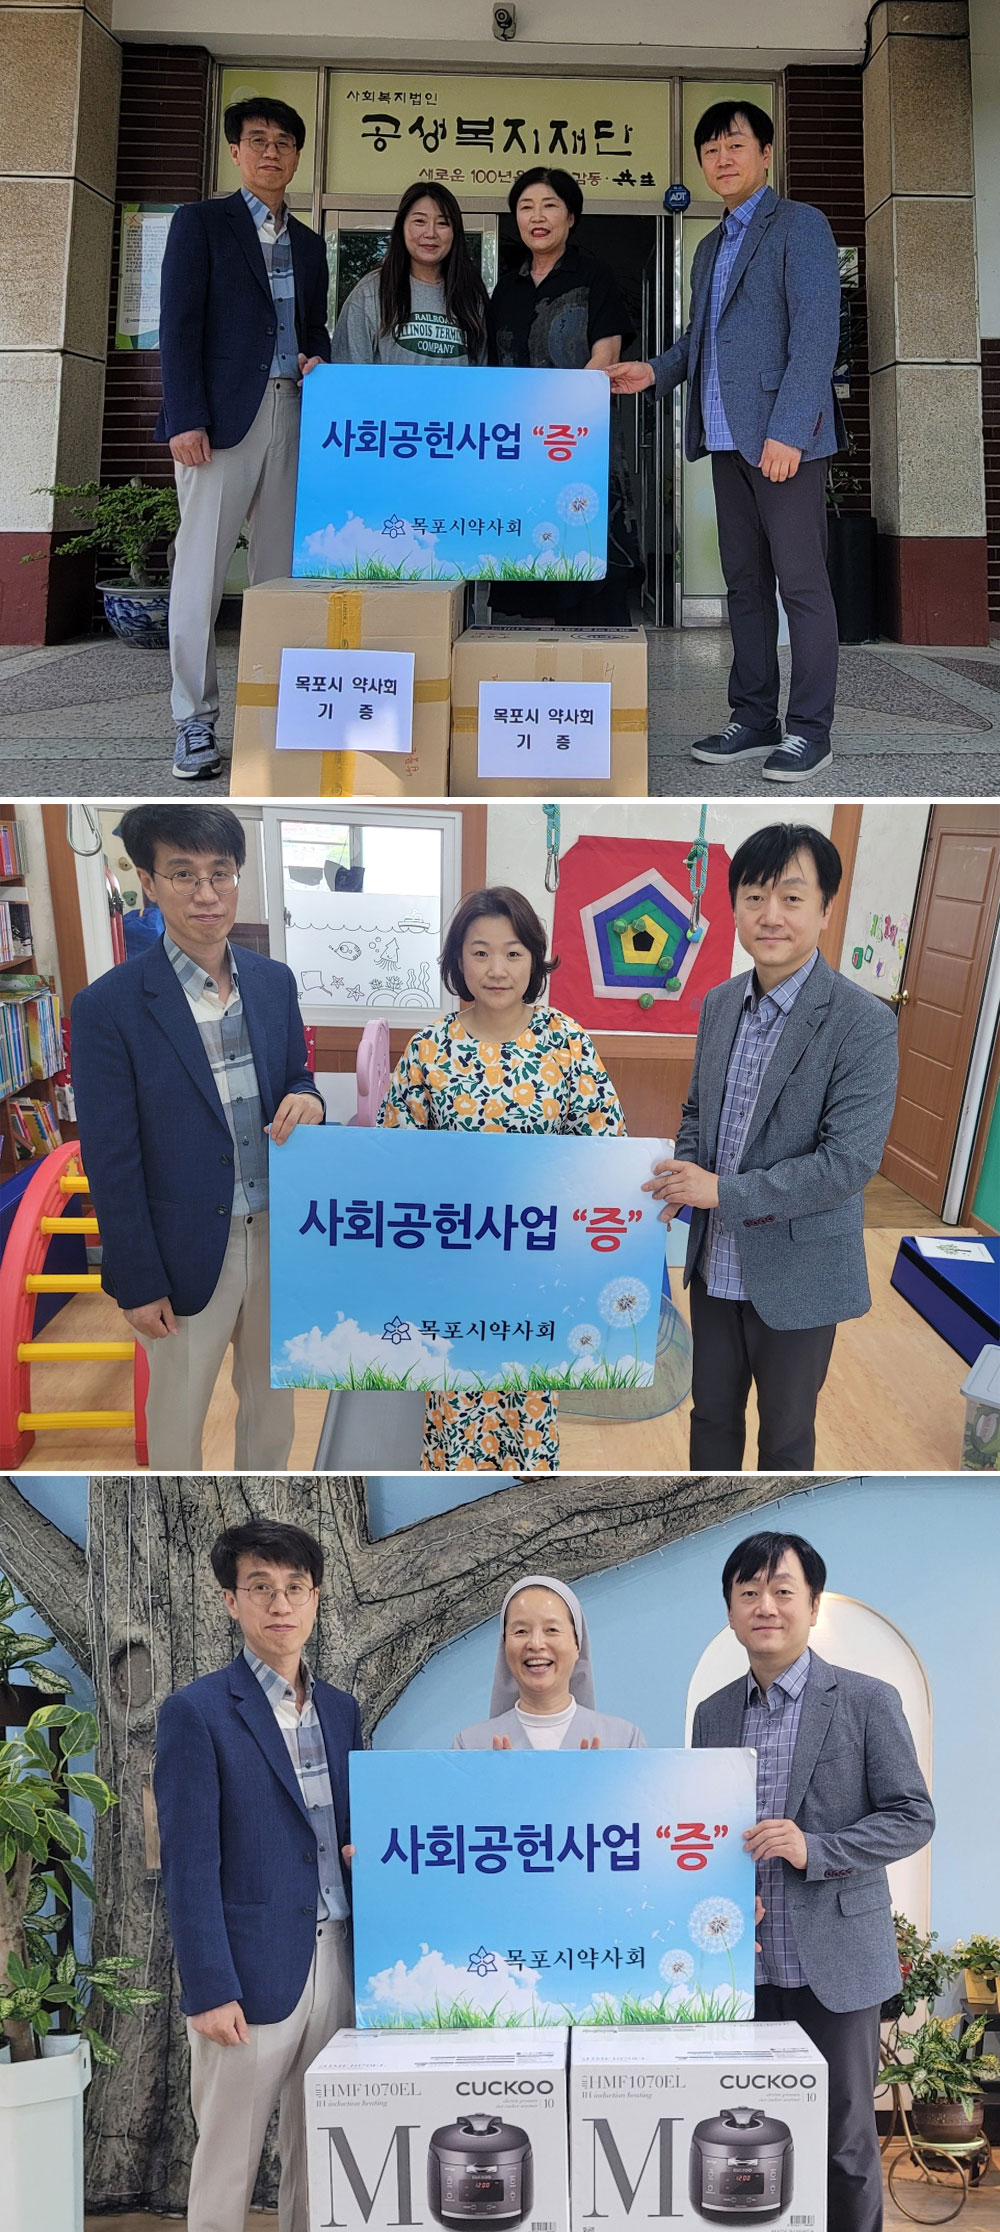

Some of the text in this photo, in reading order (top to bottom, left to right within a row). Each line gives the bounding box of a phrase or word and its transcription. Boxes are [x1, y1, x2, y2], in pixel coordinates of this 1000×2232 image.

[346, 90, 438, 106] 사회복지법인
[361, 113, 633, 157] 공생복지재단
[418, 168, 466, 182] 새로운
[669, 191, 687, 202] ADT
[417, 340, 455, 355] COMPANY
[321, 419, 521, 460] 사회공헌사업
[410, 517, 522, 537] 목포시약사회
[295, 675, 397, 696] 목포시 약사회
[317, 703, 374, 721] 기 증
[493, 708, 594, 726] 목포시 약사회
[516, 733, 571, 751] 기 증
[299, 1198, 558, 1252] 사회공헌사업
[418, 1319, 556, 1342] 목포시약사회
[380, 1822, 640, 1875] 사회공헌사업
[504, 1945, 646, 1971] 목포시약사회
[323, 2082, 422, 2098] HMF1070EL
[455, 2079, 554, 2097] CUCKOO
[589, 2074, 687, 2090] HMF1070EL
[719, 2073, 817, 2090] CUCKOO
[544, 2099, 554, 2109] 10
[807, 2092, 817, 2103] 10
[316, 2125, 424, 2228] M
[581, 2117, 685, 2218] M
